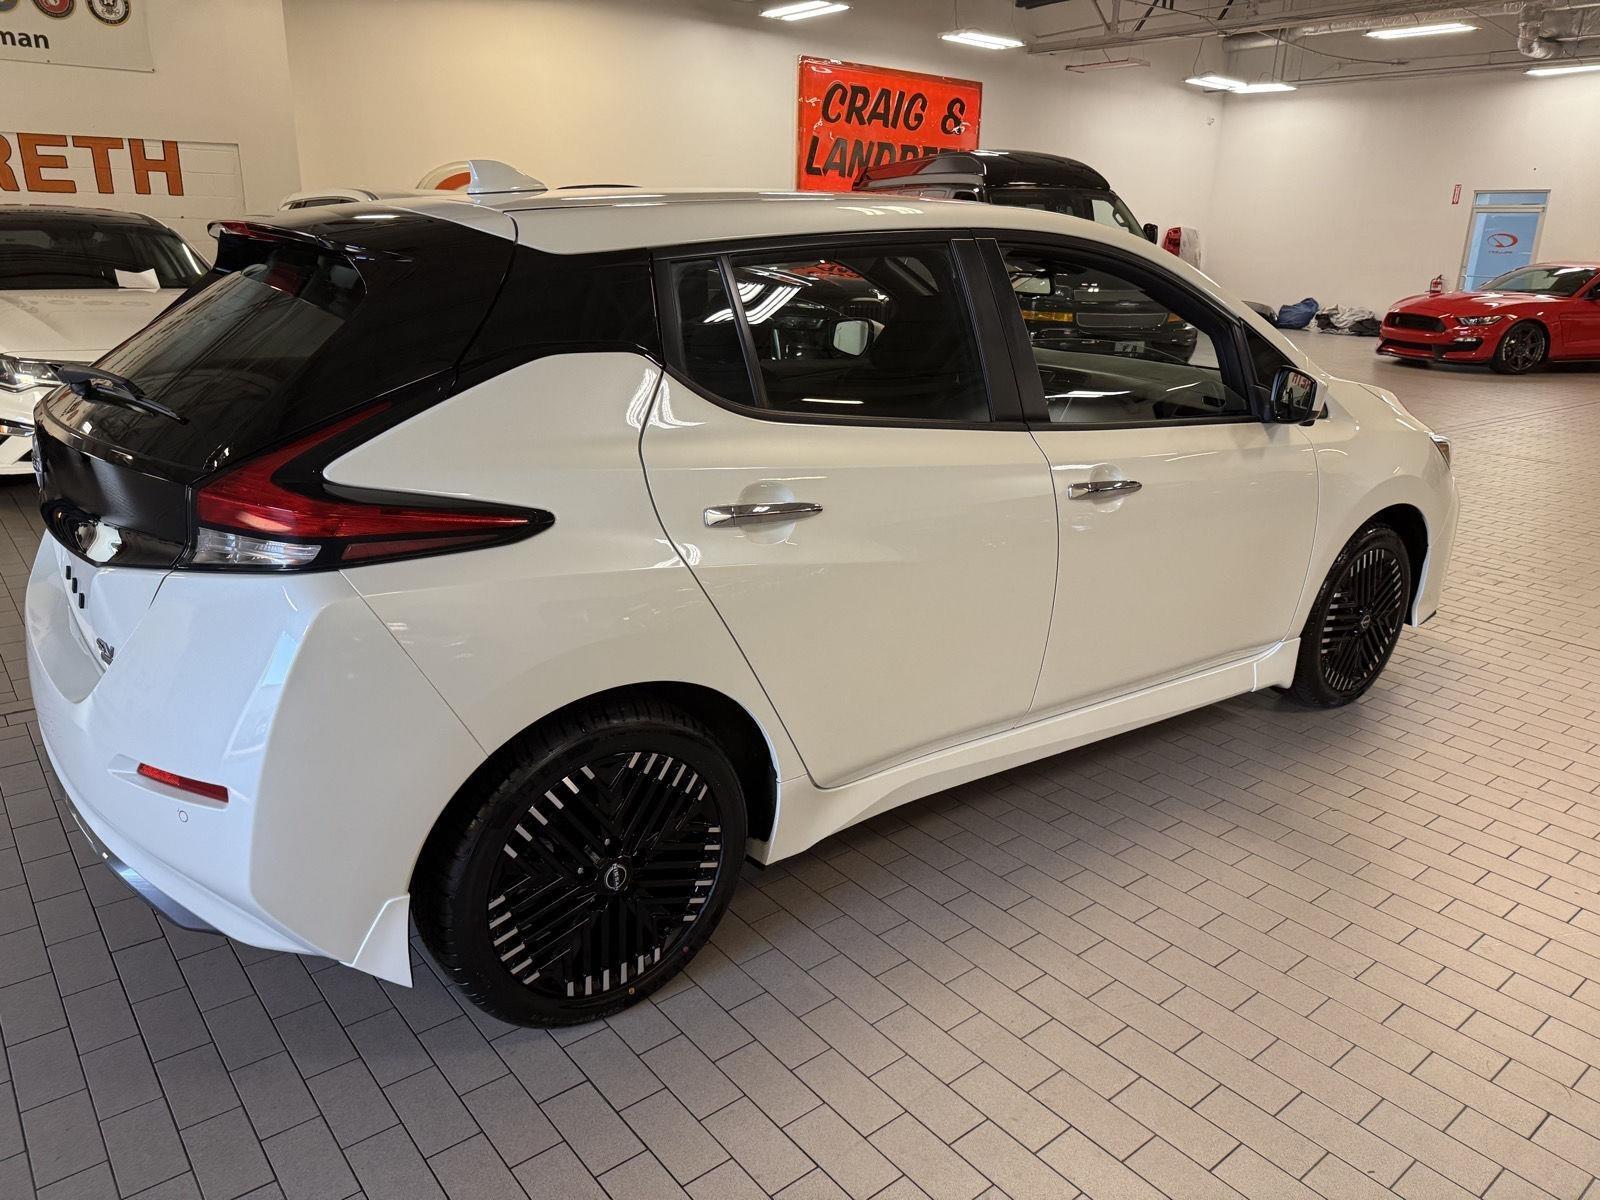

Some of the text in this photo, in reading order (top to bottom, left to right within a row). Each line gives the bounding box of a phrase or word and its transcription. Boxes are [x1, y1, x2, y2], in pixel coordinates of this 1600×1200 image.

[821, 83, 967, 135] CRAIG &
[804, 135, 972, 178] LAND
